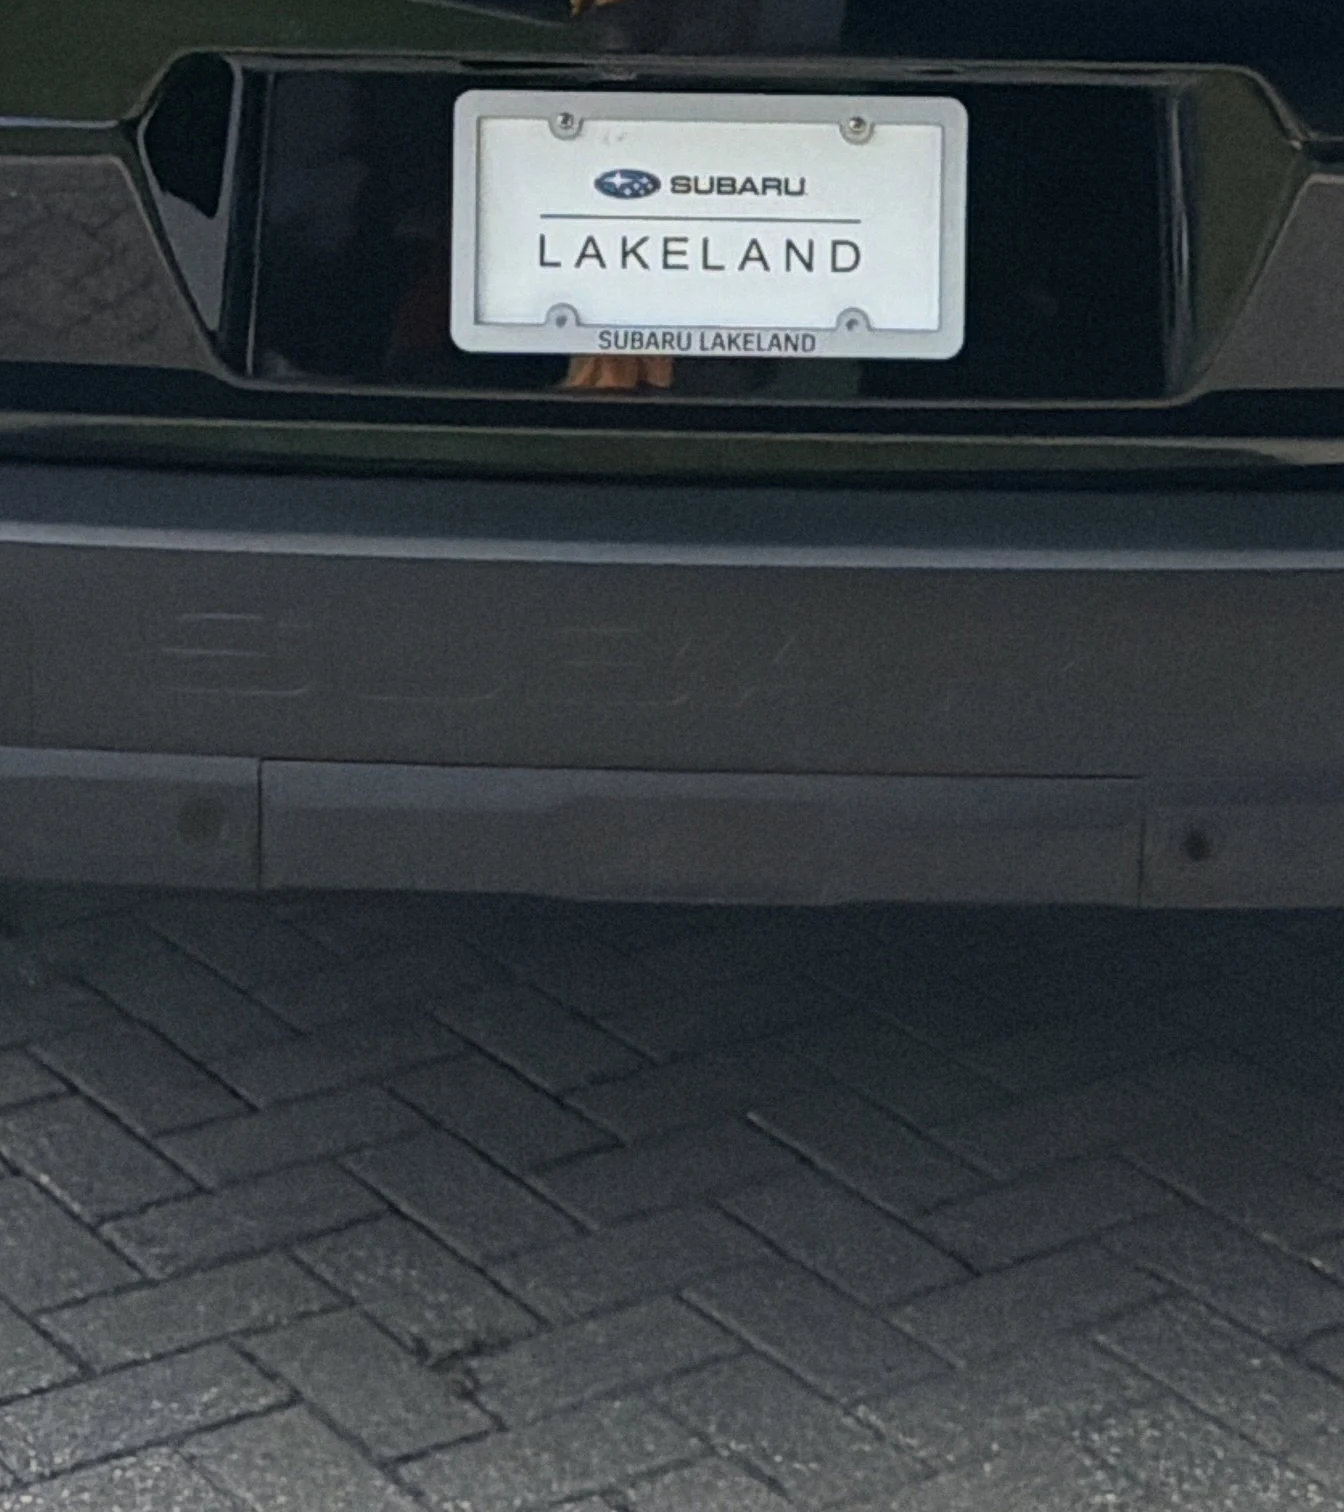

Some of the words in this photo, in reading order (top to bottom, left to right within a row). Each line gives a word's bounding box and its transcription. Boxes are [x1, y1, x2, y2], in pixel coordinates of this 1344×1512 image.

[669, 175, 807, 197] SUBARU
[538, 233, 862, 273] LAKELAND
[597, 330, 693, 352] SUBARU
[699, 332, 817, 354] LAKELAND
